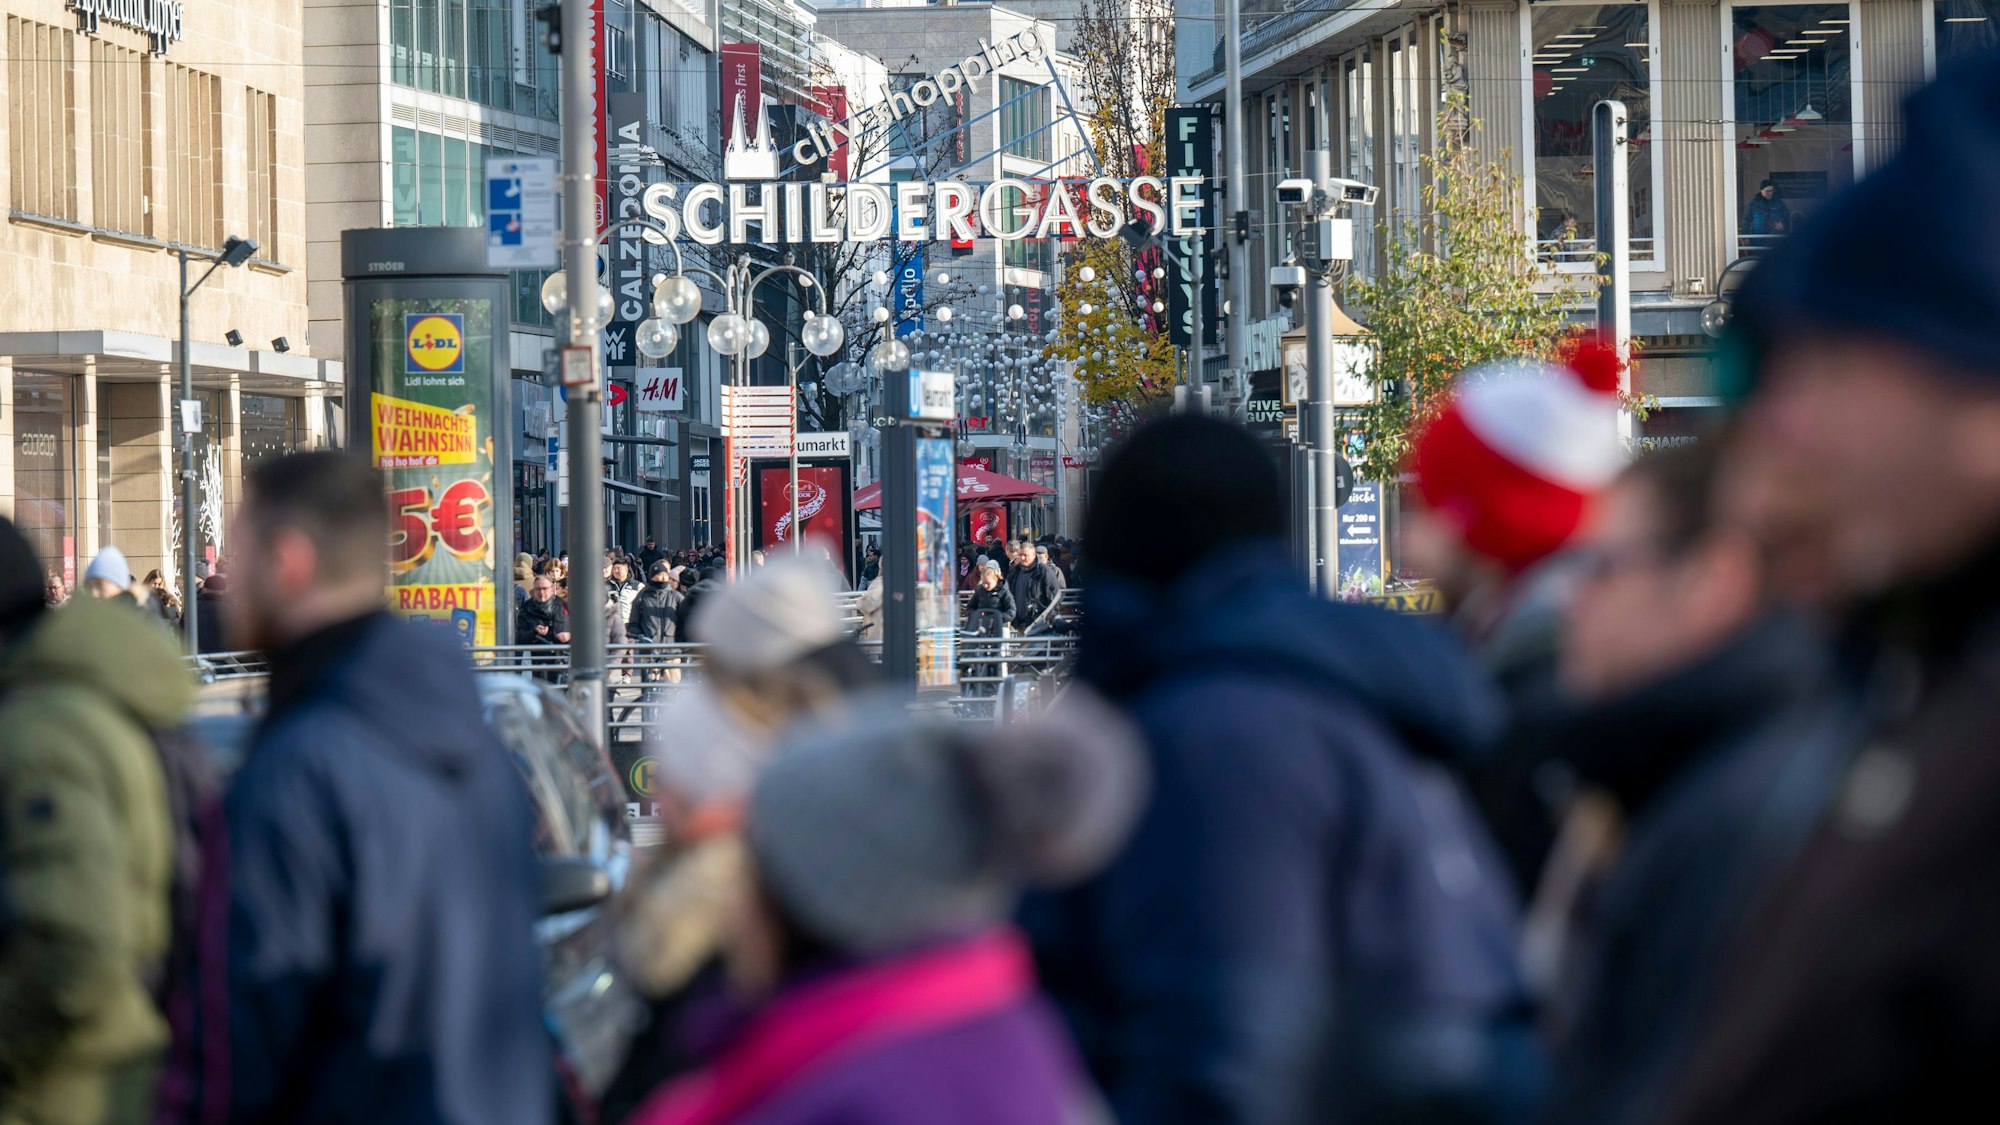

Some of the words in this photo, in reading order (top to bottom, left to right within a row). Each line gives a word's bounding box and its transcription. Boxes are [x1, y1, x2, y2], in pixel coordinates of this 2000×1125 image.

[735, 63, 747, 86] first
[793, 116, 855, 166] city
[872, 24, 1047, 128] shopping
[736, 89, 747, 126] ness
[1177, 116, 1202, 220] FIVE
[619, 121, 643, 322] CALZEDONIA
[641, 176, 1205, 245] SCHILDERGASSE
[368, 261, 405, 272] STRÖER
[901, 268, 917, 318] pollo
[405, 377, 421, 386] Lidl
[423, 377, 446, 386] lohnt
[448, 377, 465, 386] sich
[642, 376, 678, 402] H&M
[1247, 411, 1284, 422] GUYS
[1248, 400, 1281, 411] FIVE
[377, 403, 472, 433] WEIHNACHTS-
[377, 426, 472, 452] WAHNSINN
[797, 437, 846, 452] umarkt
[1632, 436, 1699, 449] KSHAKE
[381, 457, 394, 467] ho
[395, 456, 406, 466] ho
[957, 483, 991, 494] YS
[1349, 491, 1376, 503] ische
[385, 480, 490, 576] 5€
[1342, 514, 1355, 523] Nur
[1355, 513, 1368, 523] 200
[1368, 514, 1376, 523] m
[399, 586, 483, 610] RABATT
